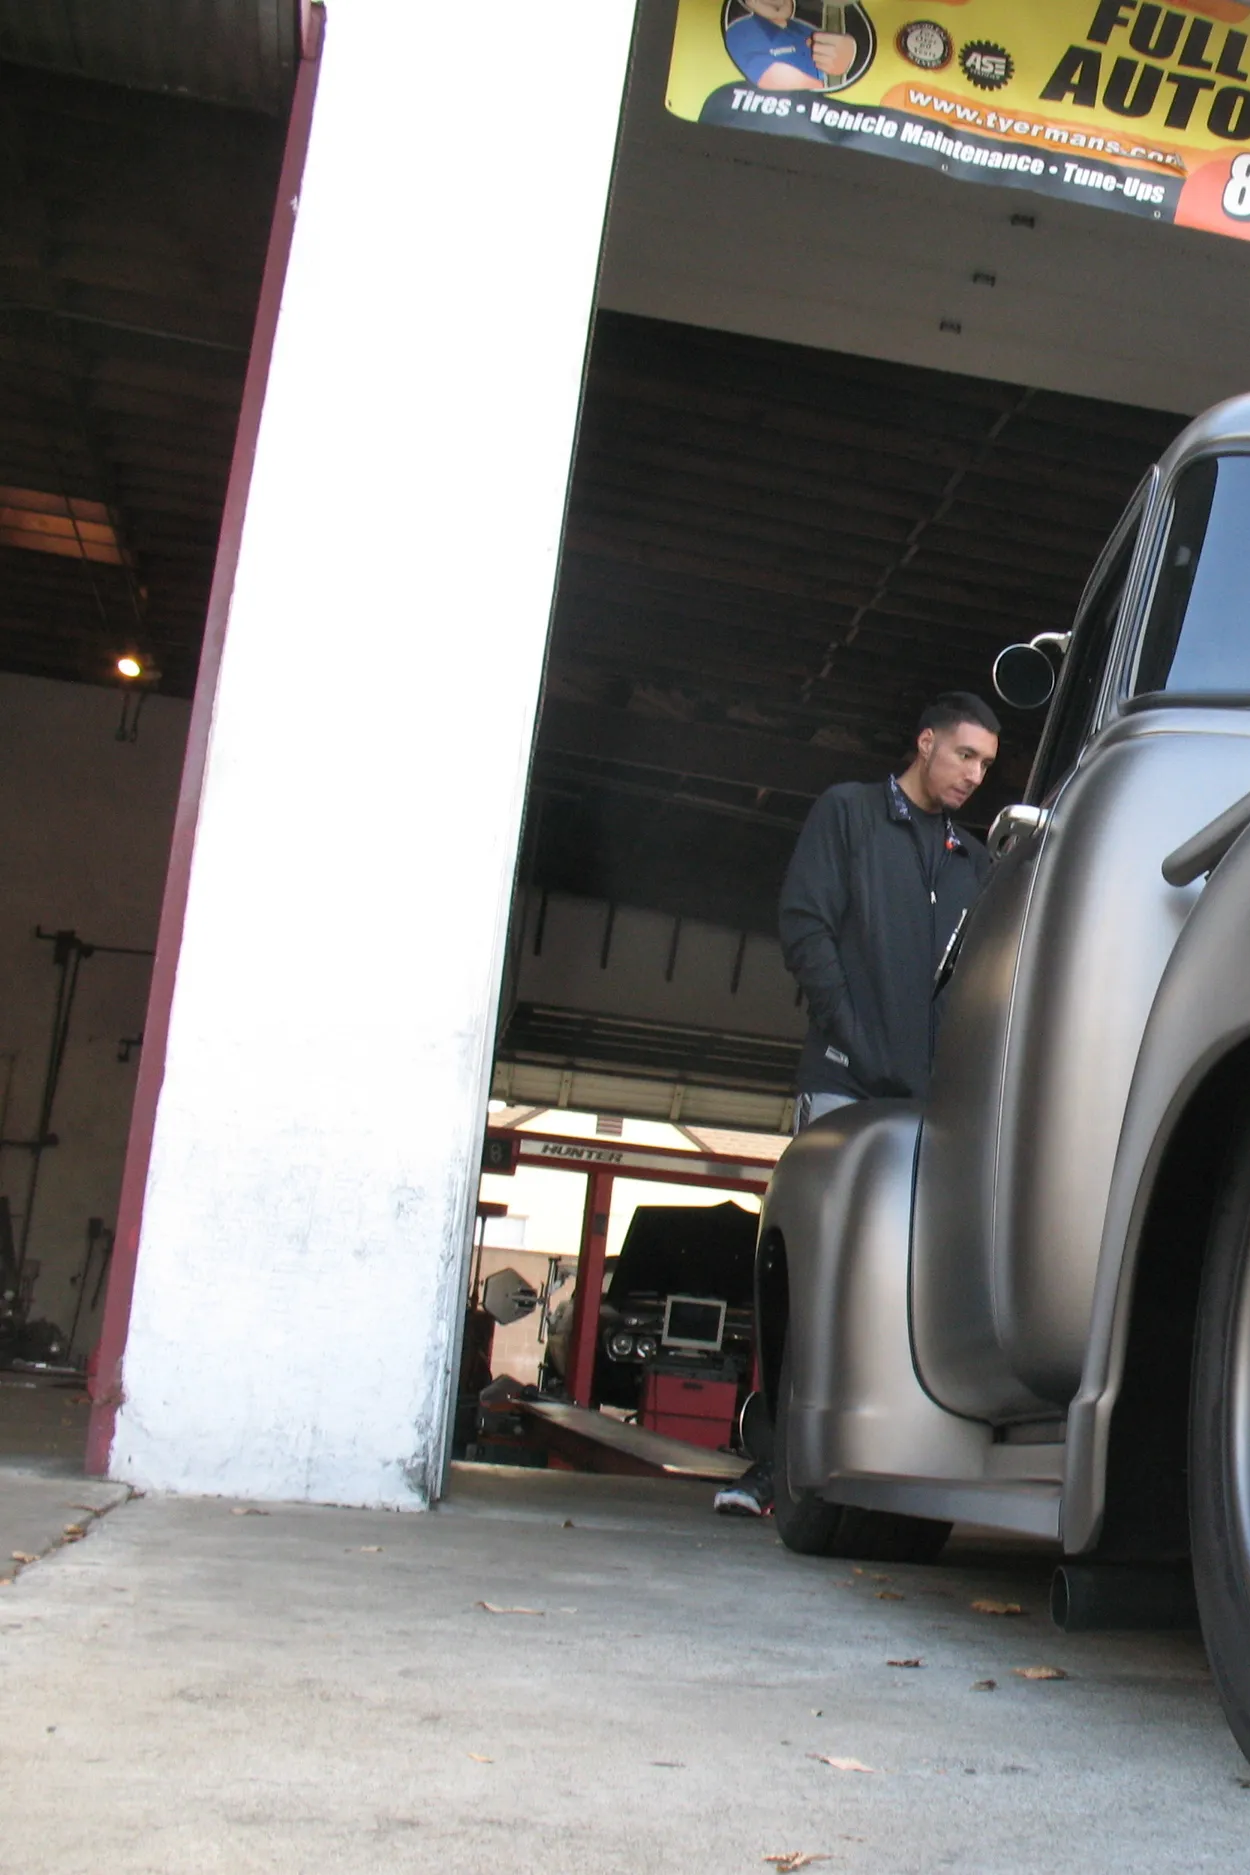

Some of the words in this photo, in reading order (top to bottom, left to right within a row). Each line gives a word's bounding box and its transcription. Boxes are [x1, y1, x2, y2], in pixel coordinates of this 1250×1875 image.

[965, 51, 1007, 76] ASE
[1087, 0, 1248, 82] FULL
[731, 88, 792, 116] Tires
[810, 101, 898, 138] Vehicle
[900, 121, 1045, 175] Maintenance
[1063, 162, 1165, 204] Tune-Ups
[541, 1143, 623, 1163] HUNTER
